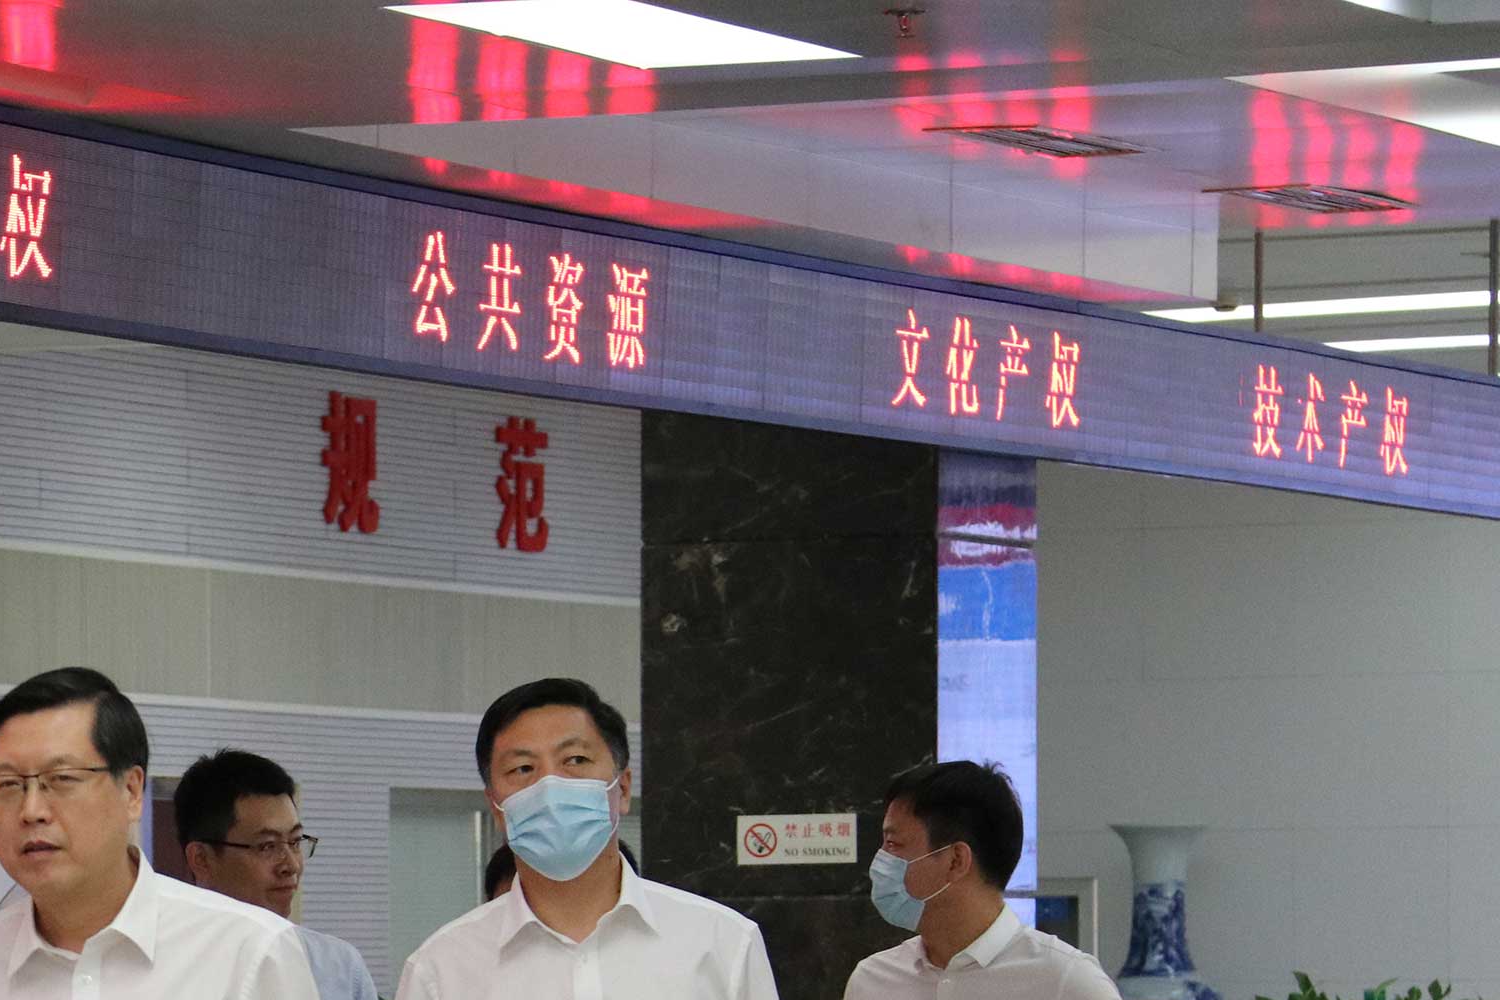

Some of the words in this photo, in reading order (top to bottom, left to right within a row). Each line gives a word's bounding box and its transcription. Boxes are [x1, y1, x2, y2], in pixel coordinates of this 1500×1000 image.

[412, 230, 650, 369] 公共资源
[891, 308, 1081, 429] 文化产权
[1252, 364, 1409, 475] 技术产权
[784, 848, 799, 857] NO
[802, 847, 851, 857] SMOKING
